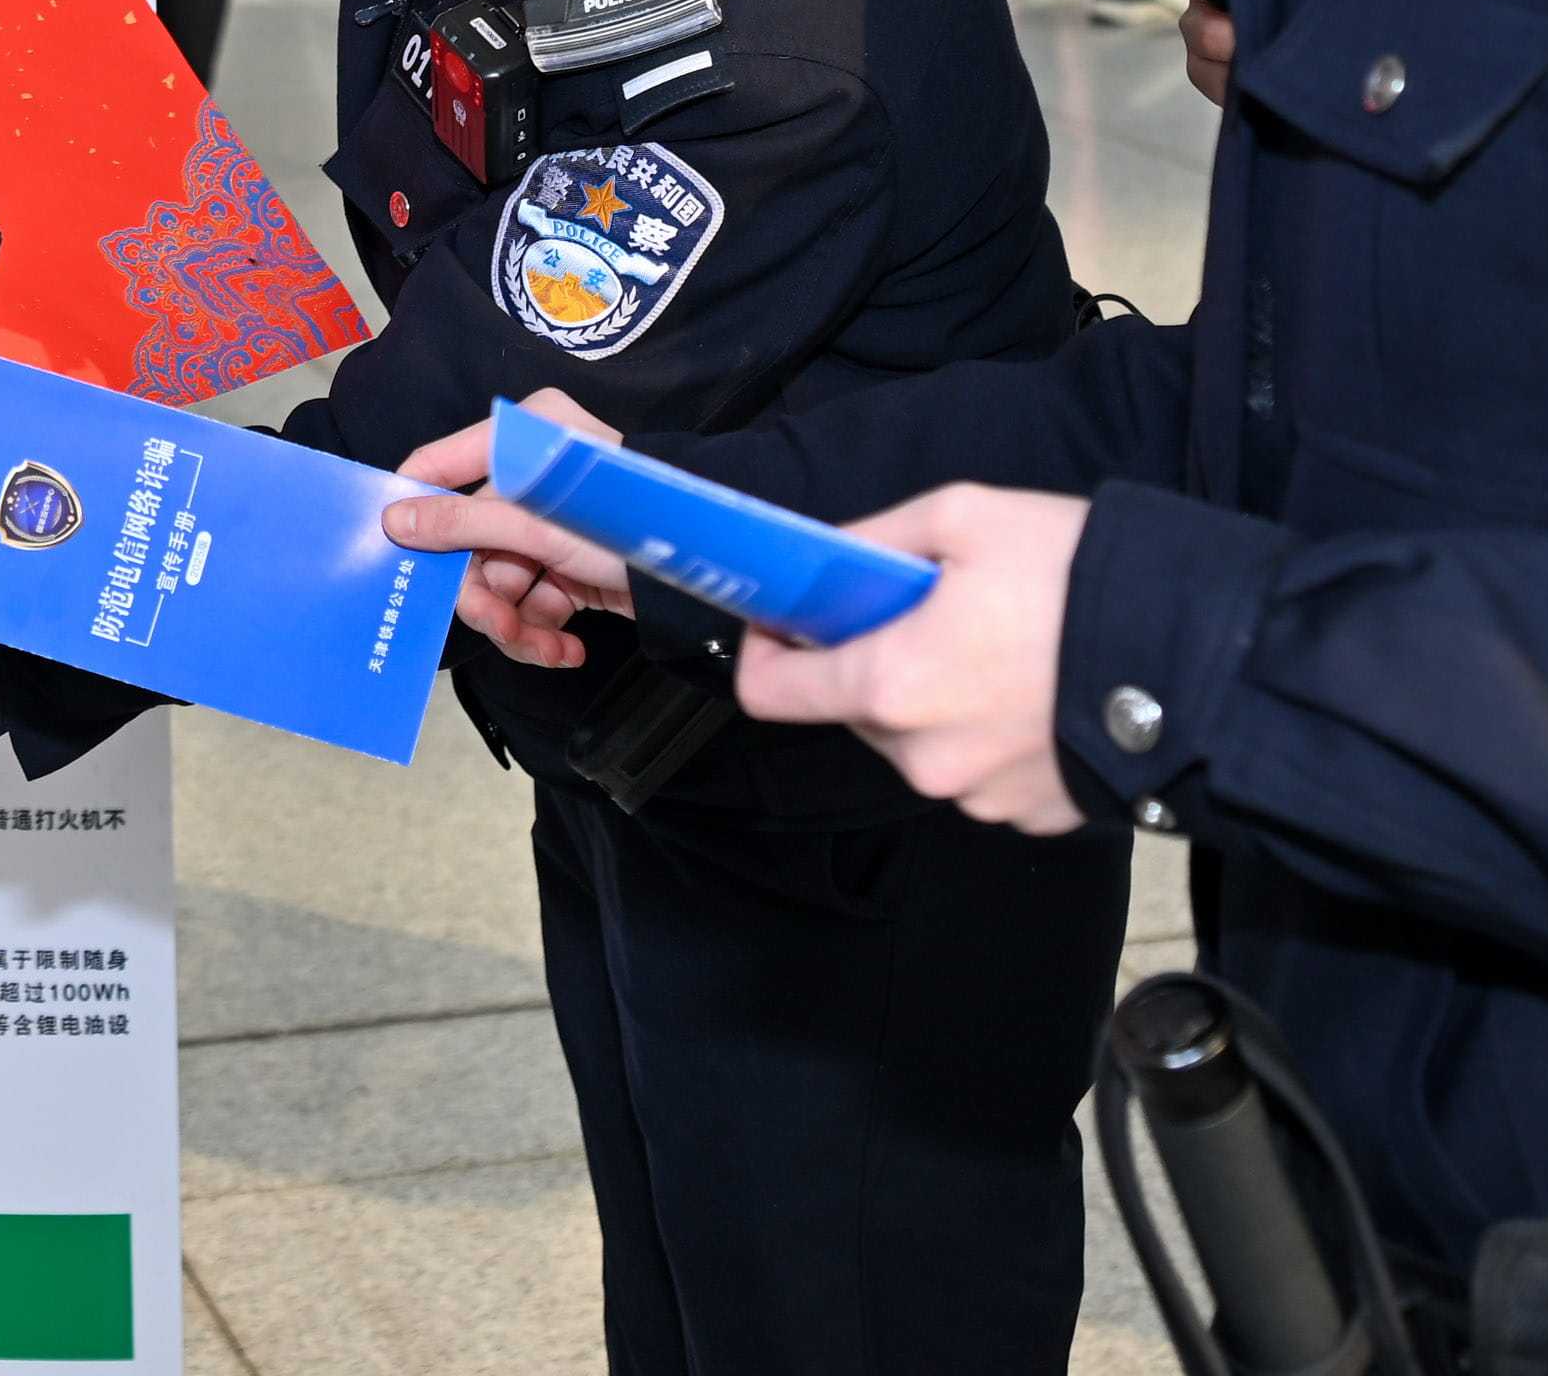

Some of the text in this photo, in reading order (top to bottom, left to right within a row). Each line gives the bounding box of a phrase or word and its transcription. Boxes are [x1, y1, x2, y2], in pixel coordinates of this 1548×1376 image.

[553, 220, 625, 265] POLICE
[90, 436, 180, 643] 防范电信网络诈骗
[156, 511, 197, 596] 宣传手册
[368, 558, 416, 674] 天津铁路公安处
